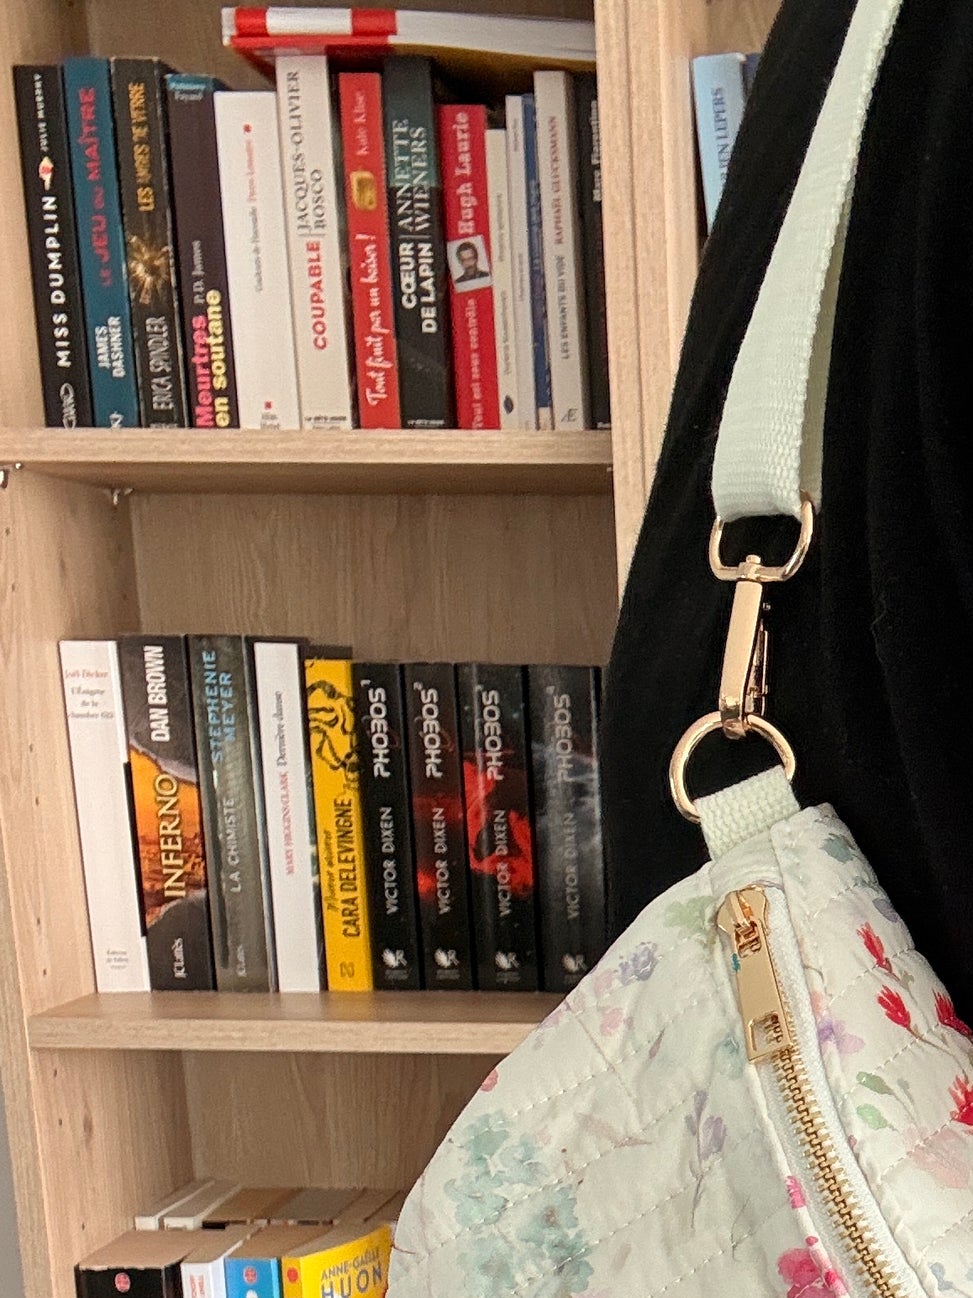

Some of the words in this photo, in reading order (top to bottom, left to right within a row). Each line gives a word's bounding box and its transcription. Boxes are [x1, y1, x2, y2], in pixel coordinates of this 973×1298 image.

[286, 70, 311, 231] JACQUES-OLIVIER
[452, 111, 473, 176] Laurie
[309, 168, 328, 231] BOSCO
[392, 117, 415, 233] ANNETTE
[409, 126, 432, 233] WIENERS
[456, 181, 479, 235] Hugh
[42, 196, 66, 305] DUMPLIN
[91, 214, 109, 265] JEU
[305, 240, 328, 351] COUPABLE
[365, 286, 382, 308] un
[398, 240, 419, 310] CŒUR
[417, 241, 436, 303] LAPIN
[51, 313, 71, 368] MISS
[95, 326, 111, 369] JAMES
[107, 315, 127, 379] DASHNER
[144, 315, 172, 374] SPINDLER
[205, 288, 227, 391] soutane
[367, 309, 391, 336] par
[420, 305, 438, 335] DE
[191, 315, 214, 428] Meurtres
[363, 334, 394, 369] finit
[151, 375, 175, 411] ERICA
[212, 395, 230, 428] en
[364, 370, 389, 406] Tout
[143, 645, 168, 705] BROWN
[148, 707, 171, 742] DAN
[201, 649, 223, 764] STEPHENIE
[218, 671, 237, 741] MEYER
[367, 686, 392, 780] PHOBOS
[419, 687, 444, 779] PHOBOS
[481, 689, 505, 781] PHOBOS
[553, 693, 575, 783] PHOBOS
[154, 774, 187, 898] INFERNO
[221, 796, 241, 867] CHIMISTE
[332, 797, 358, 893] DELEVINGNE
[379, 806, 396, 853] DIXEN
[430, 806, 448, 854] DIXEN
[492, 809, 510, 856] DIXEN
[561, 812, 579, 858] DIXEN
[228, 871, 242, 894] LA
[382, 859, 400, 915] VICTOR
[434, 859, 452, 915] VICTOR
[495, 861, 513, 918] VICTOR
[564, 864, 581, 919] VICTOR
[339, 896, 362, 938] CARA
